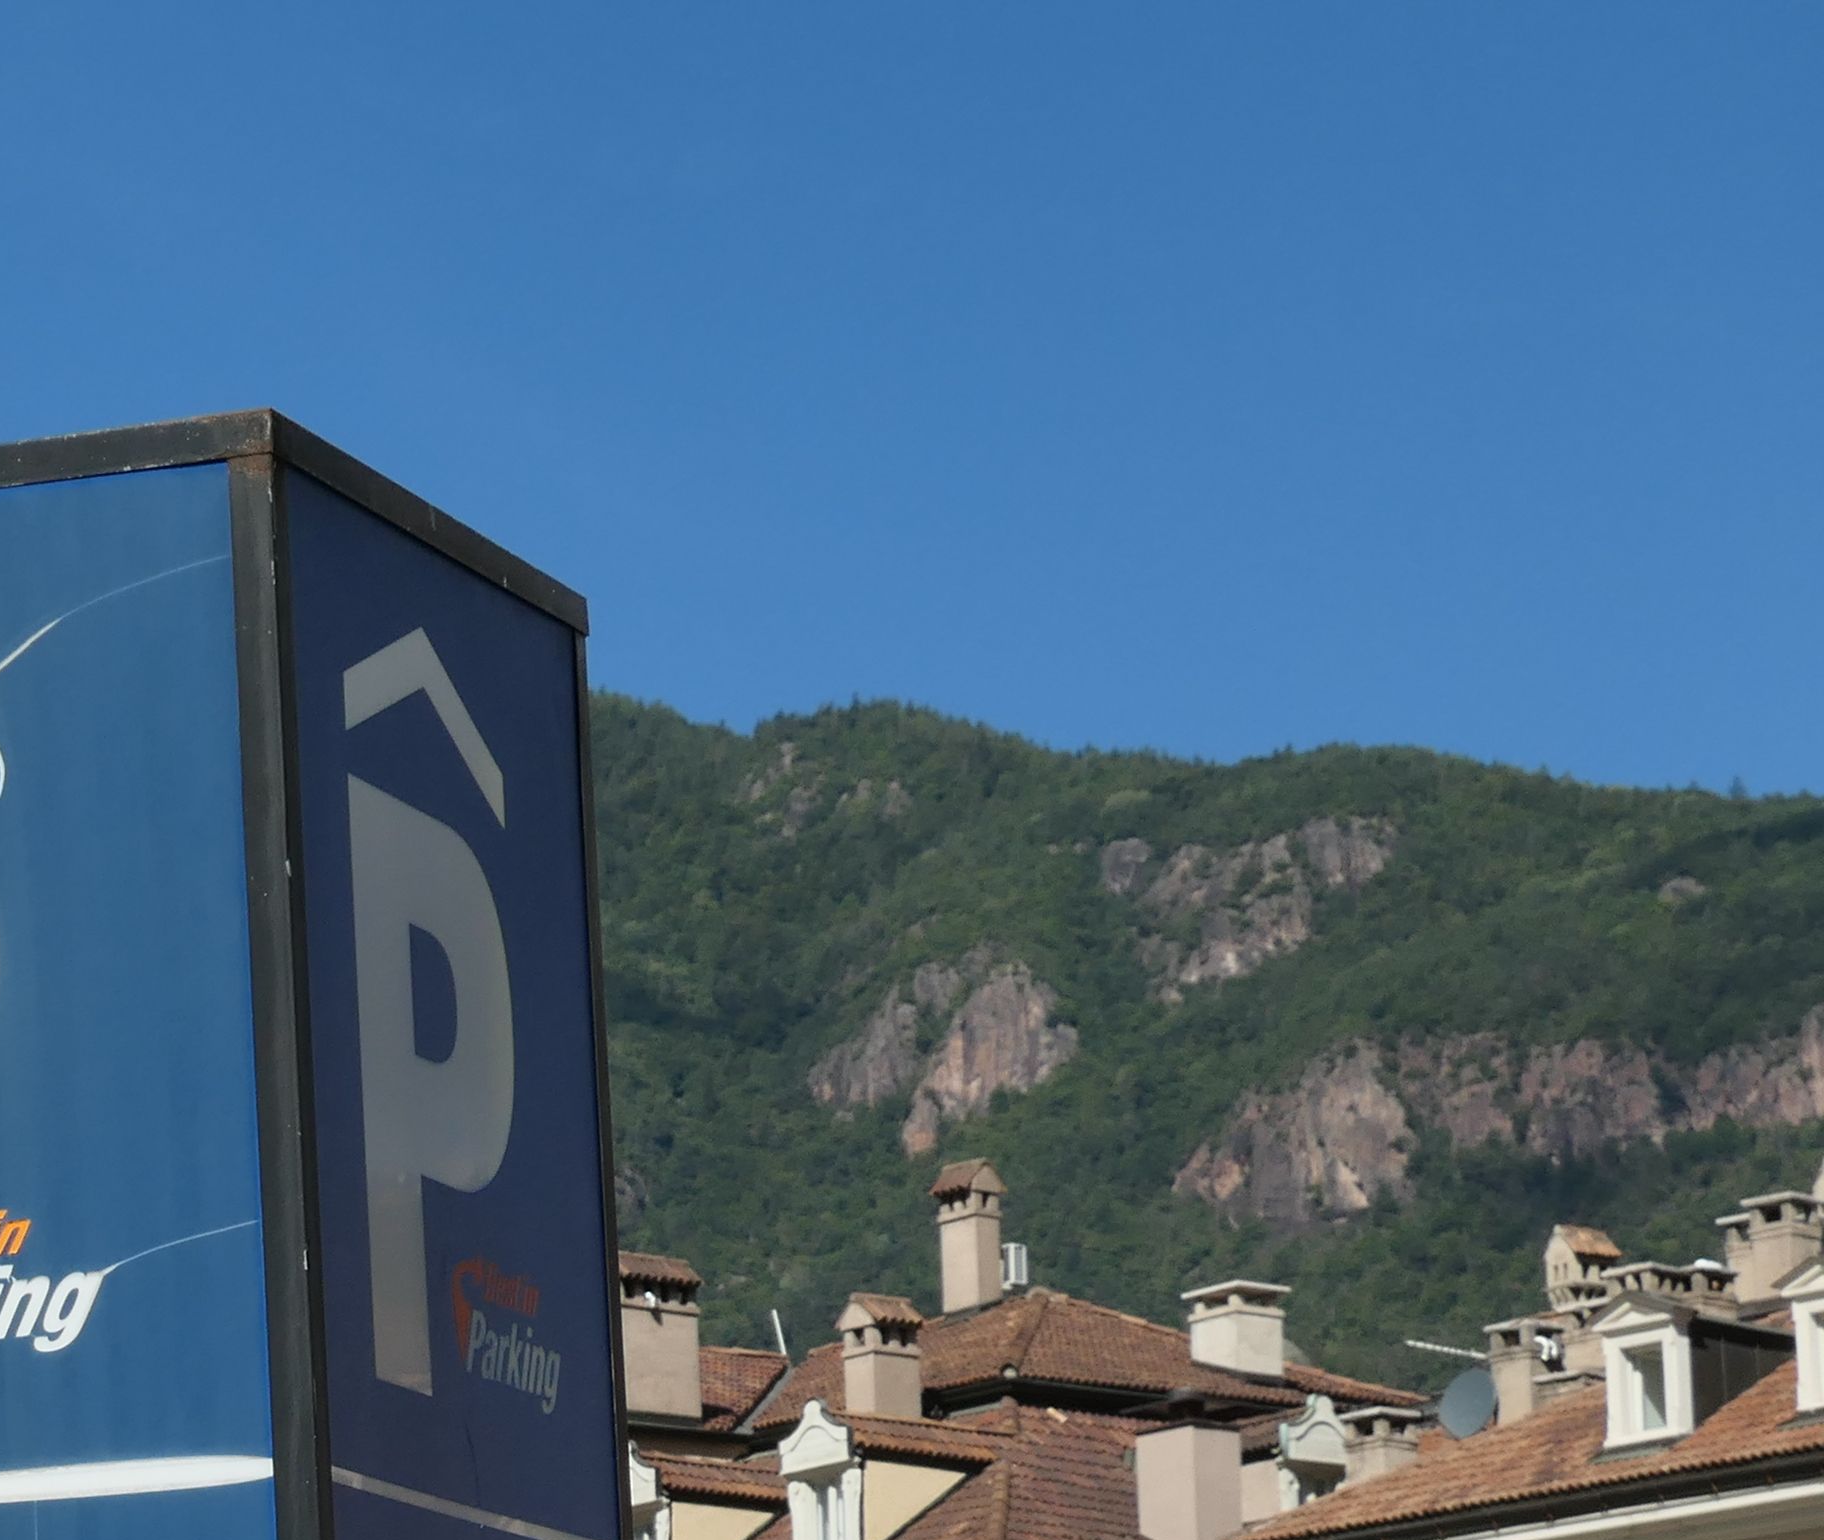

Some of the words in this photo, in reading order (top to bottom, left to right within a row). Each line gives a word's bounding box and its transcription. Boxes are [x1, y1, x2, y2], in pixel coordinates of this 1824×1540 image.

[347, 771, 512, 1397] P
[484, 1262, 521, 1308] Best
[522, 1283, 539, 1314] in
[466, 1311, 561, 1414] Parking
